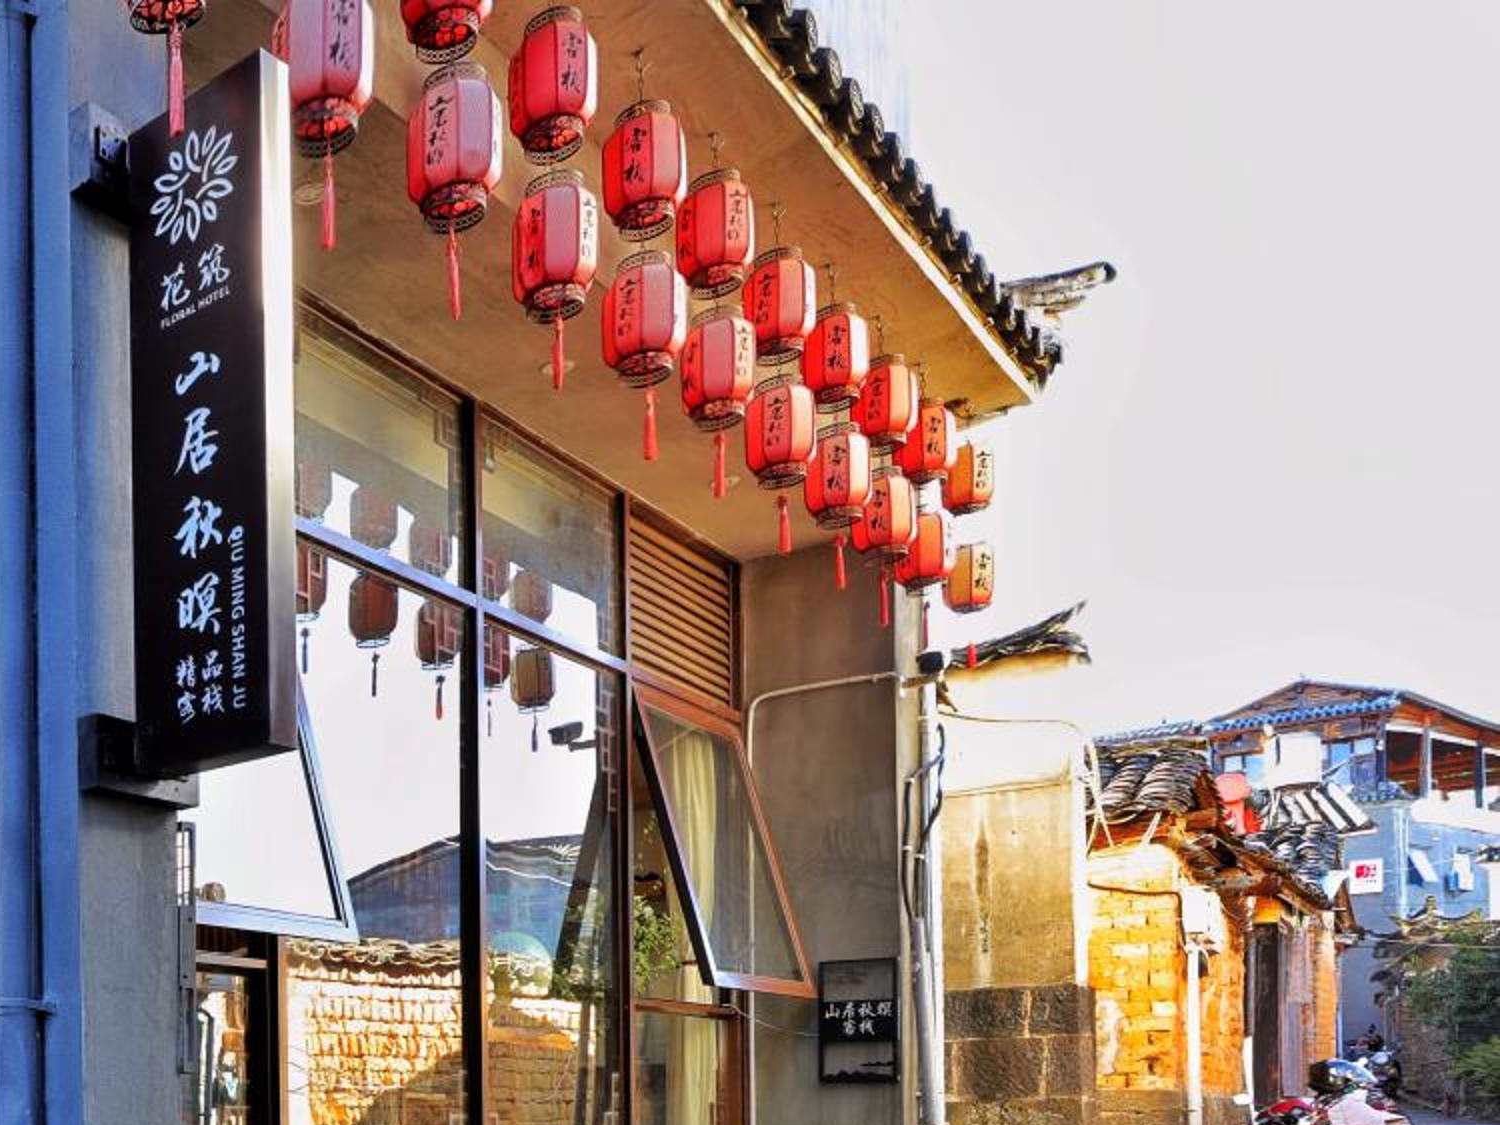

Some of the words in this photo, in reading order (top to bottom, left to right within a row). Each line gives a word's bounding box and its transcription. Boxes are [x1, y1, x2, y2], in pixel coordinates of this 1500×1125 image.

[160, 304, 197, 331] FLORAL
[197, 285, 230, 310] HOTEL
[228, 525, 244, 561] QIU
[231, 566, 245, 620] MING
[231, 623, 245, 678] SHAN
[232, 684, 246, 709] JU
